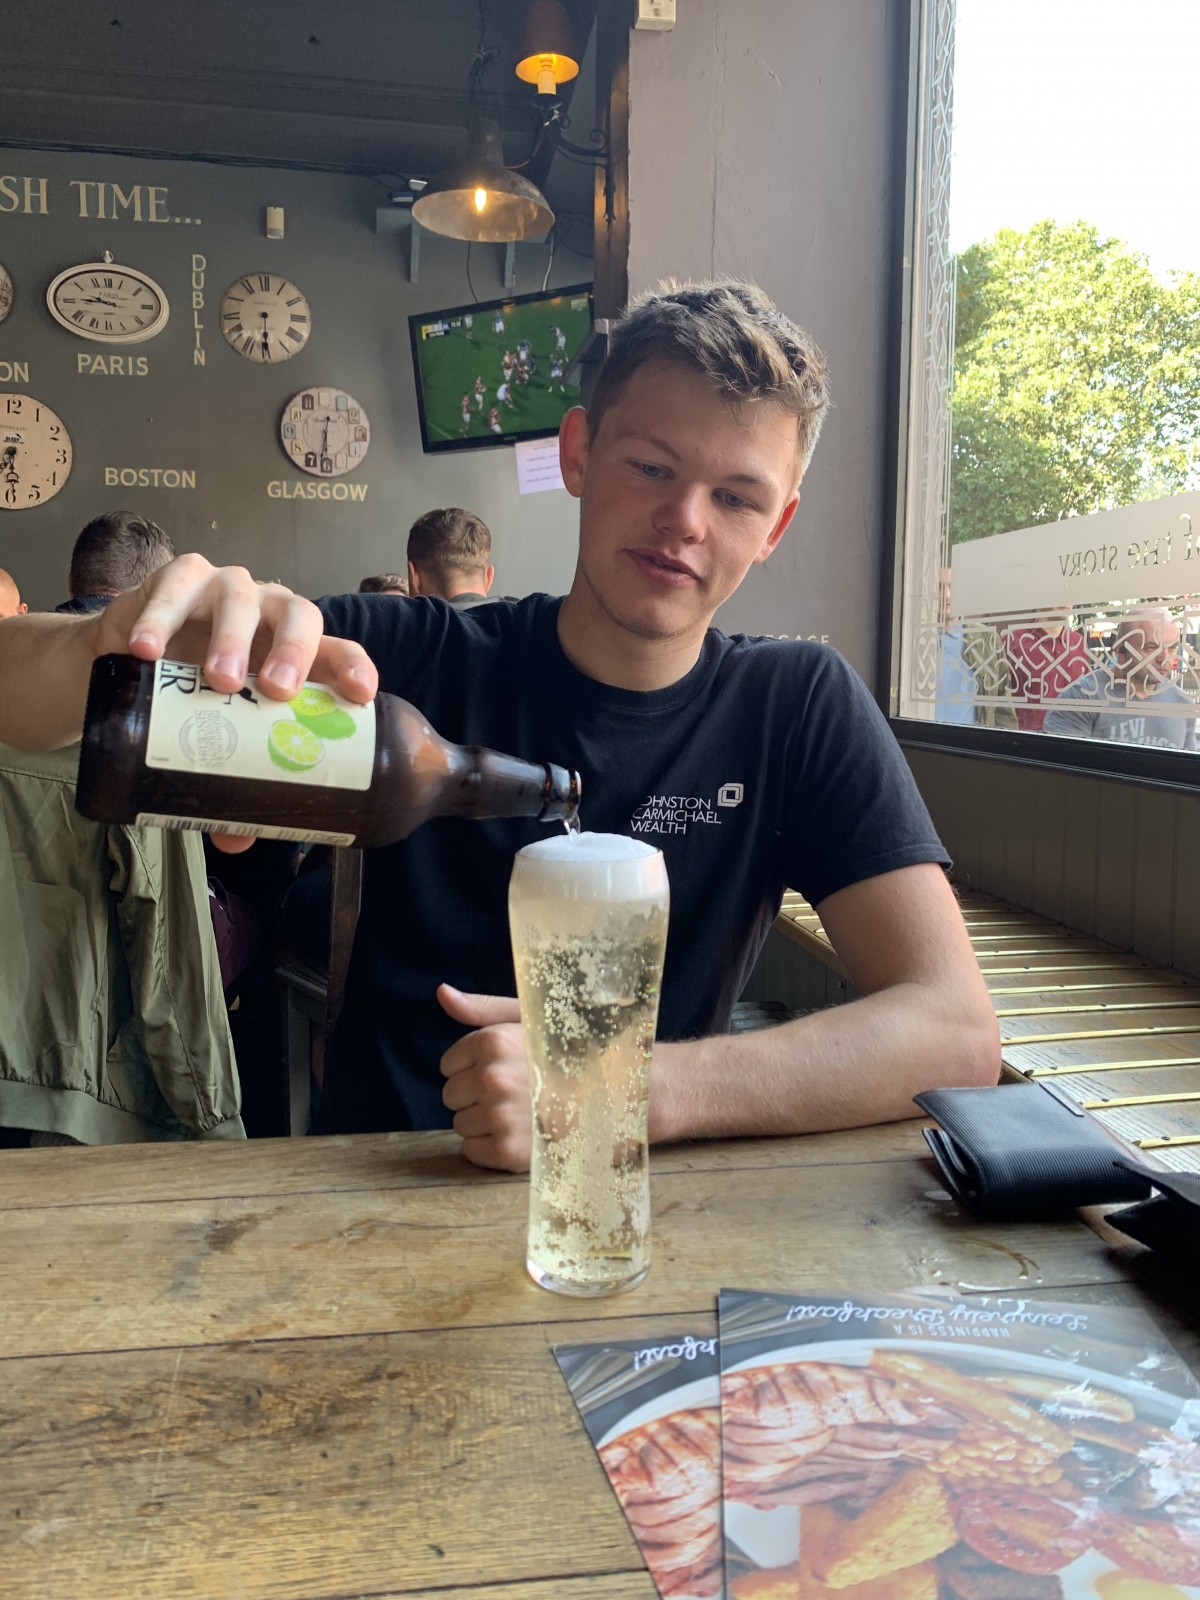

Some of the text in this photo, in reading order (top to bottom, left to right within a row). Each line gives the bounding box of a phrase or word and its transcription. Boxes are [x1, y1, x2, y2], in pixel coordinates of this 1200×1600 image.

[70, 180, 202, 225] TIME...
[192, 254, 207, 366] DUBLIN
[77, 353, 149, 376] PARIS
[6, 398, 22, 414] 12
[50, 425, 60, 442] 2
[56, 448, 67, 464] 3
[307, 455, 315, 466] 7
[323, 460, 331, 472] 6
[46, 470, 57, 486] 4
[104, 467, 196, 490] BOSTON
[28, 485, 40, 500] 5
[266, 480, 368, 502] GLASGOW
[640, 795, 712, 810] OHNSTON
[632, 807, 722, 824] CARMICHAEL
[630, 819, 687, 835] WEALTH
[784, 1301, 1088, 1332] Leisurely Breakfast!
[892, 1324, 1010, 1338] HAPPINESS IS A
